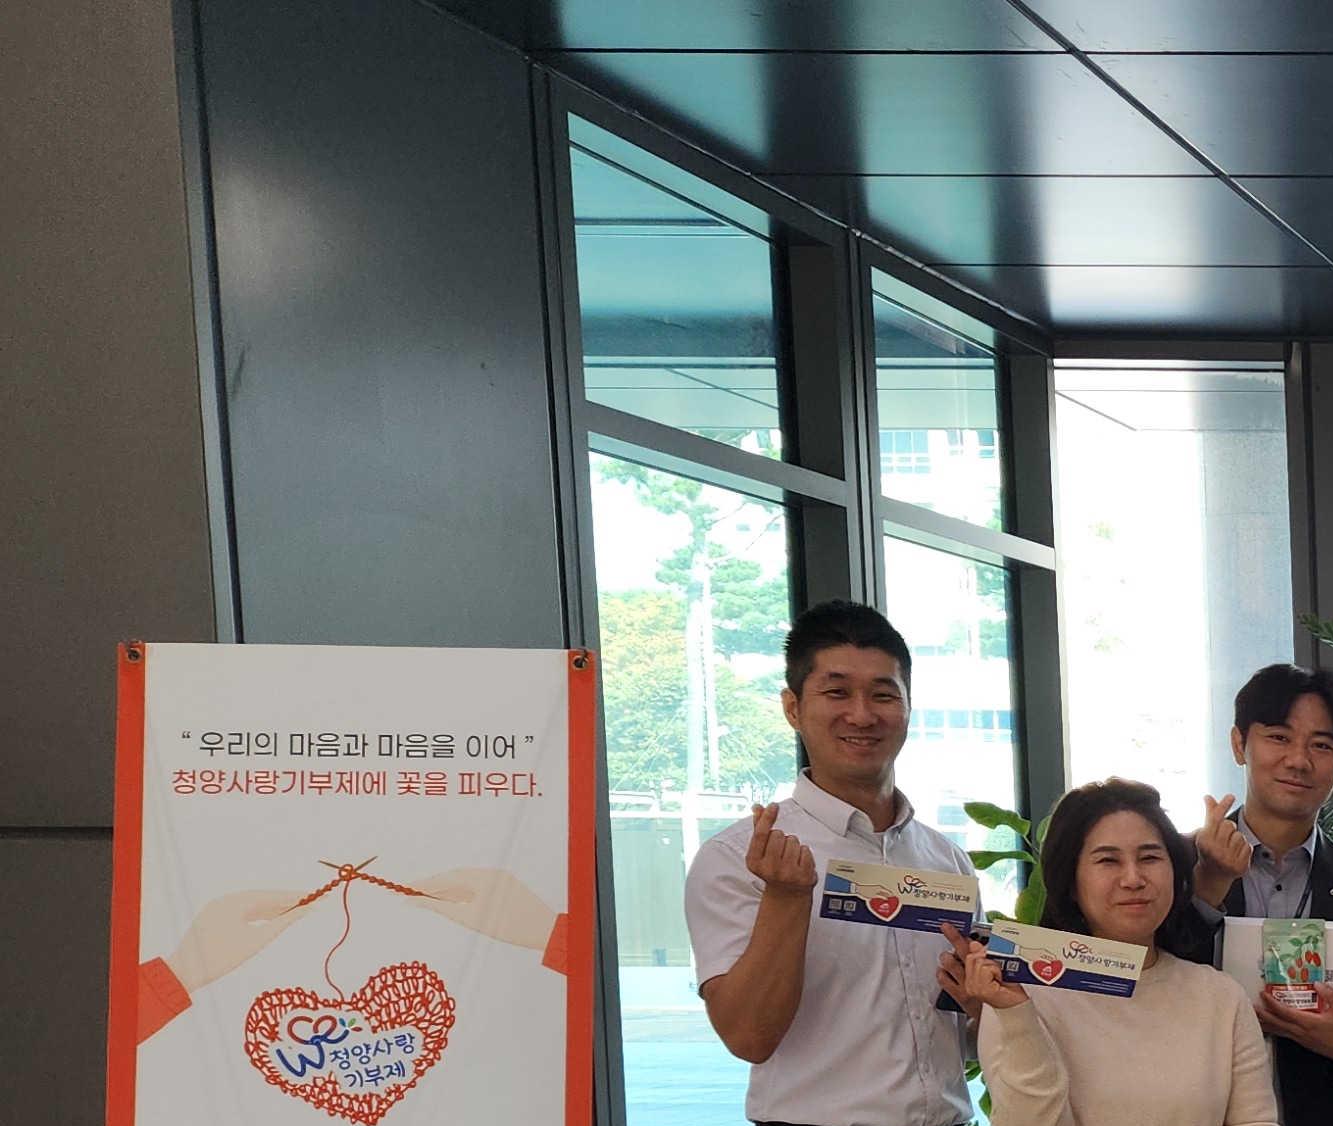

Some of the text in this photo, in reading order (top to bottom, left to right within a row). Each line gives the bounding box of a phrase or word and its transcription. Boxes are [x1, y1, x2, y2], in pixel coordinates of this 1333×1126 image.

[199, 731, 278, 758] 우리의
[288, 732, 370, 759] 마음과
[376, 732, 456, 760] 마음을
[465, 734, 517, 760] 이어
[171, 769, 543, 799] 청양사랑기부제에 꽃을 피우다.
[329, 1032, 416, 1069] 청양사랑
[343, 1062, 407, 1090] 기부제
